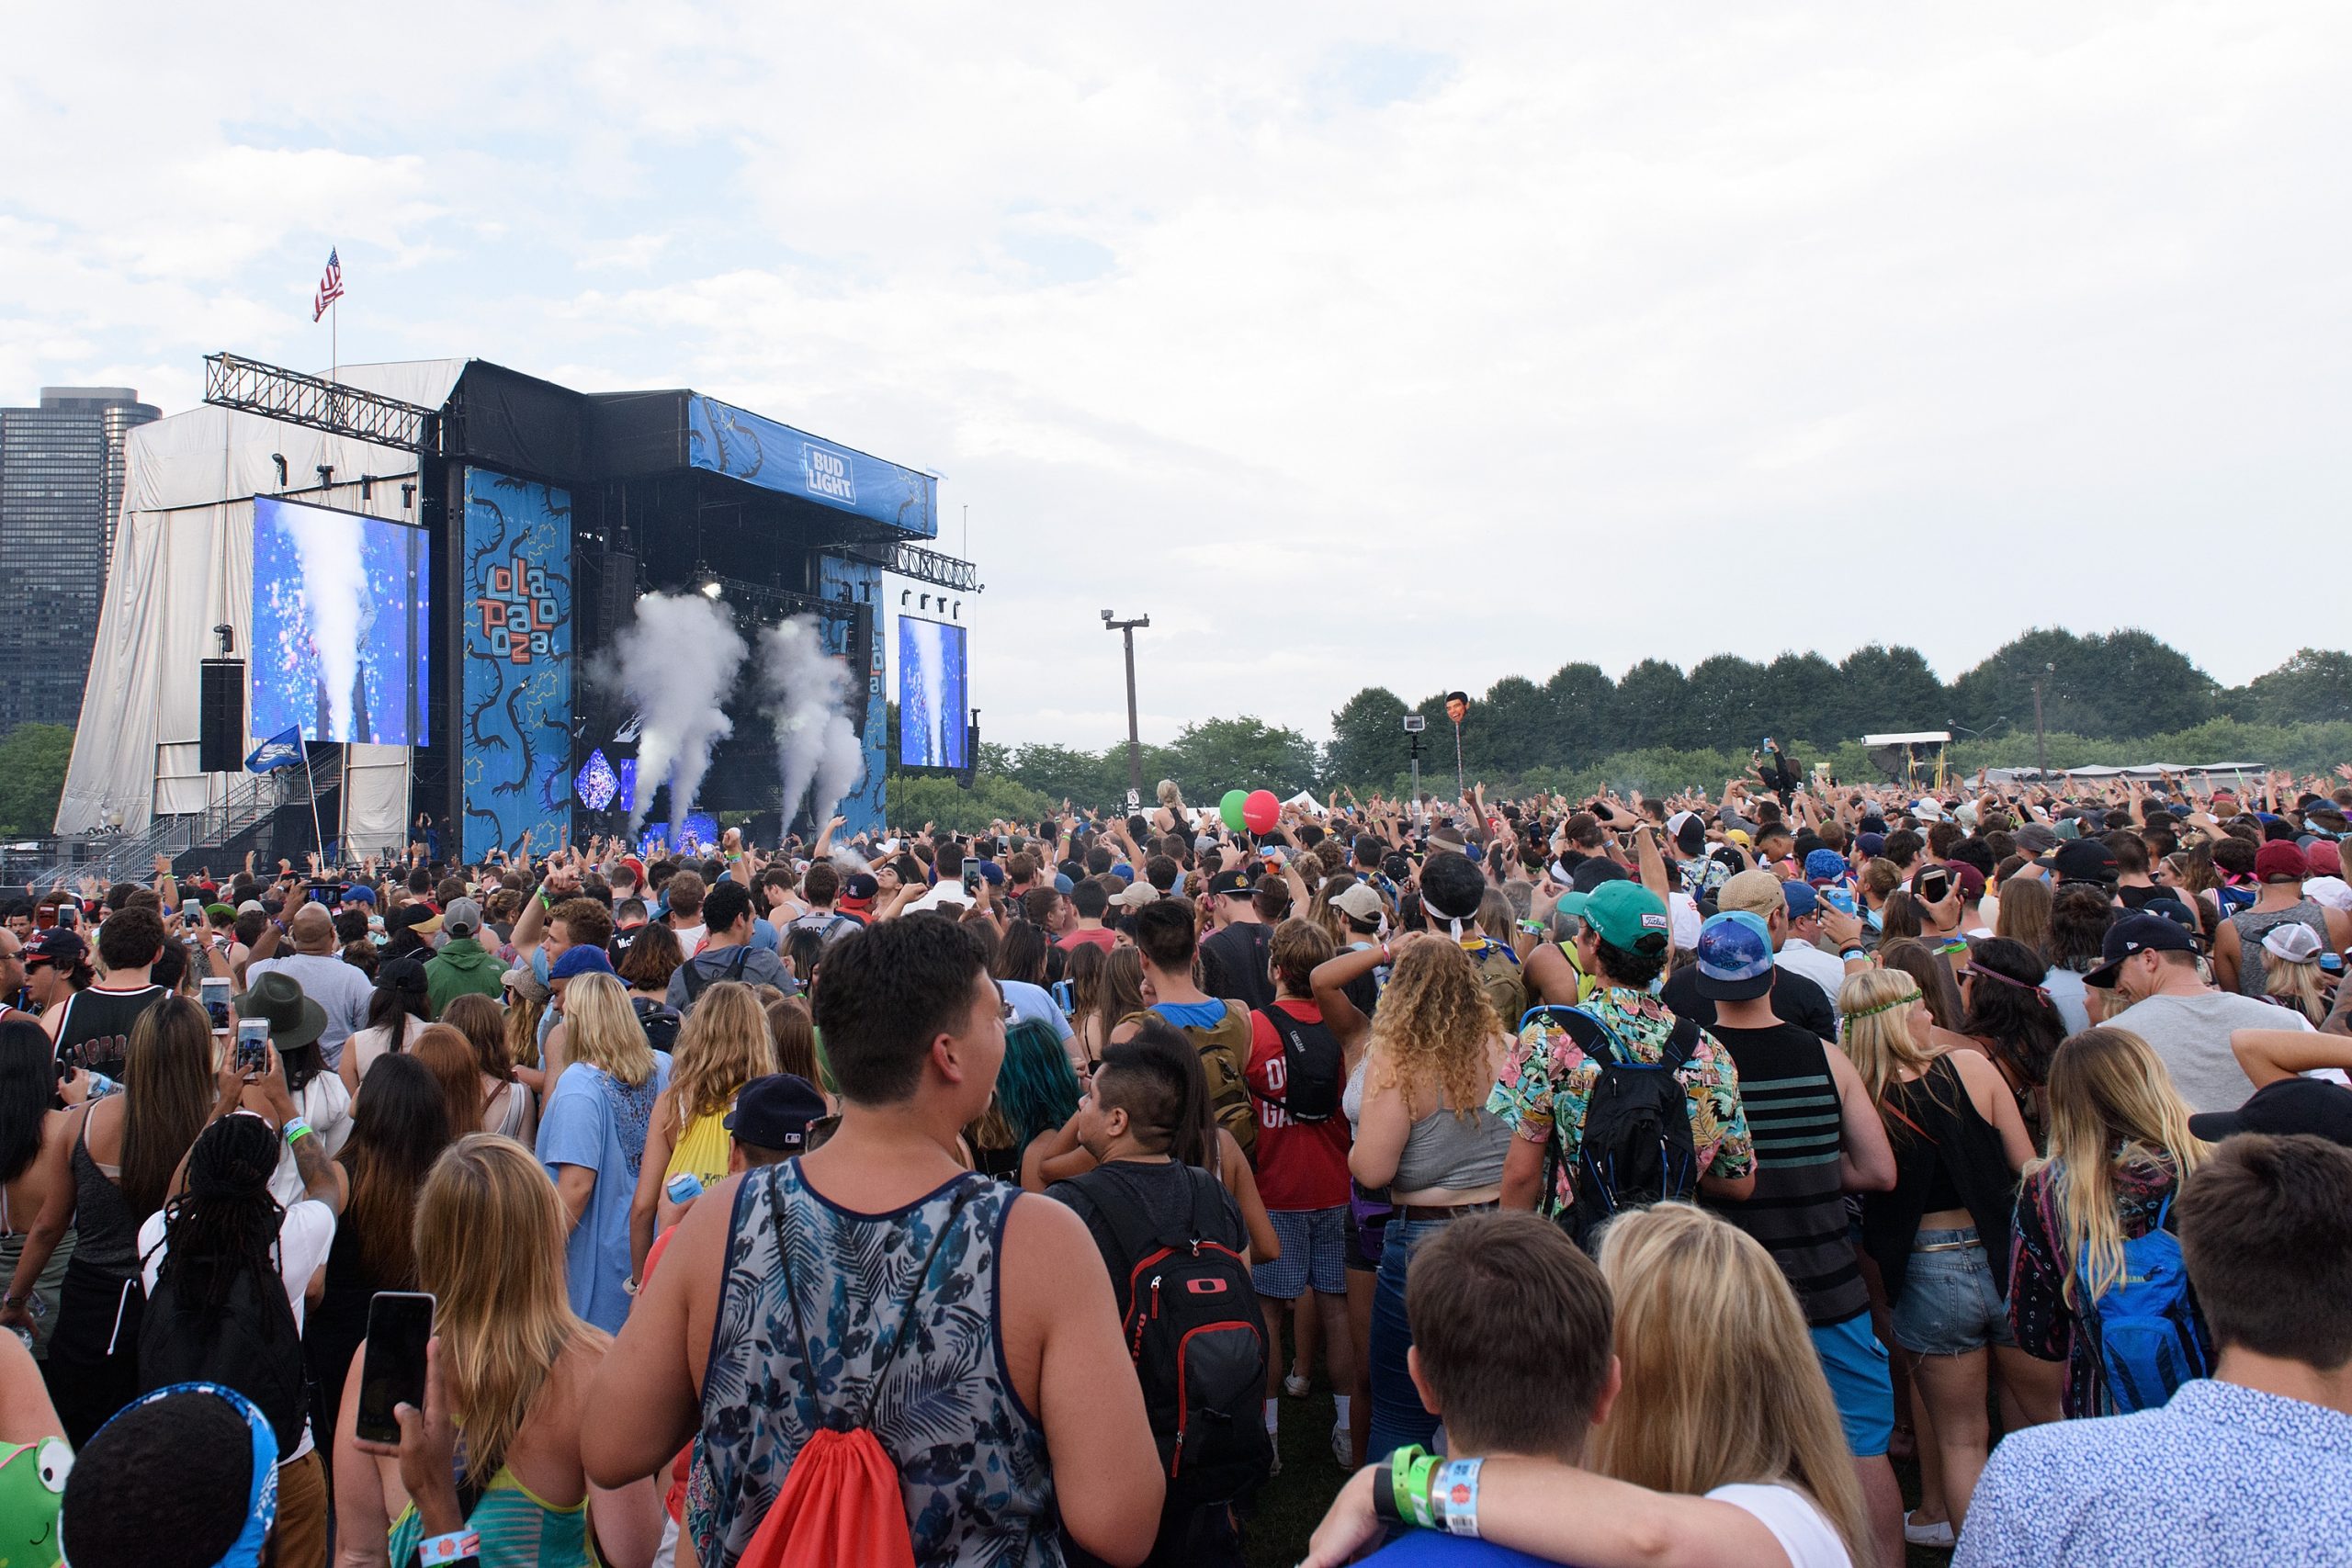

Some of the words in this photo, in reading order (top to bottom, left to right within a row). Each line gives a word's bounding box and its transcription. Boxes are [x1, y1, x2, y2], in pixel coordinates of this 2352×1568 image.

[813, 451, 844, 478] BUD
[808, 468, 851, 499] LIGHT
[73, 1033, 128, 1069] JORD
